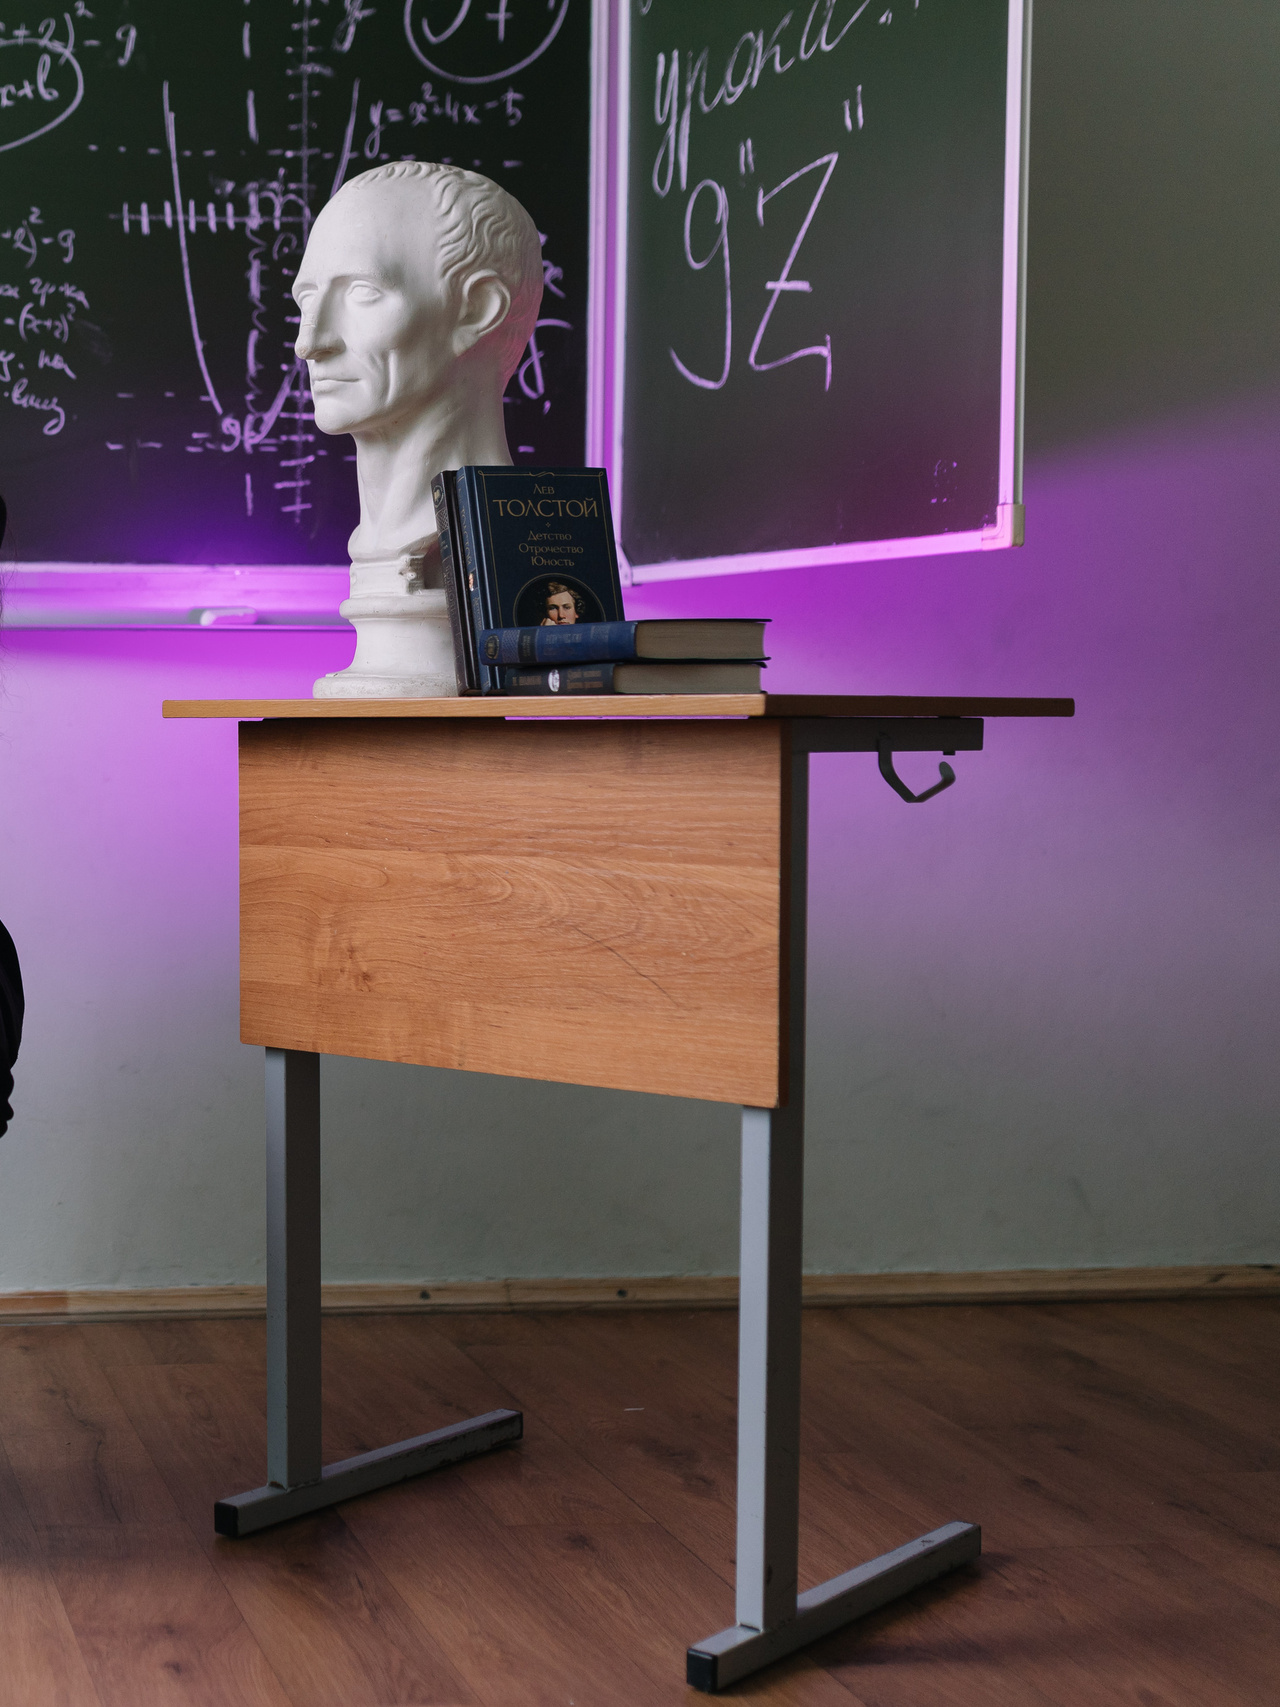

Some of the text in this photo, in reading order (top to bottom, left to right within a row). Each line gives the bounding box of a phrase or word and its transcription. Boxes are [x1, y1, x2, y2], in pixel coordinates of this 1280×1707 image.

[492, 497, 598, 518] ТОЛСТОЙ
[527, 530, 572, 542] Детство
[518, 542, 584, 556] Отрочество
[531, 556, 575, 567] Юность
